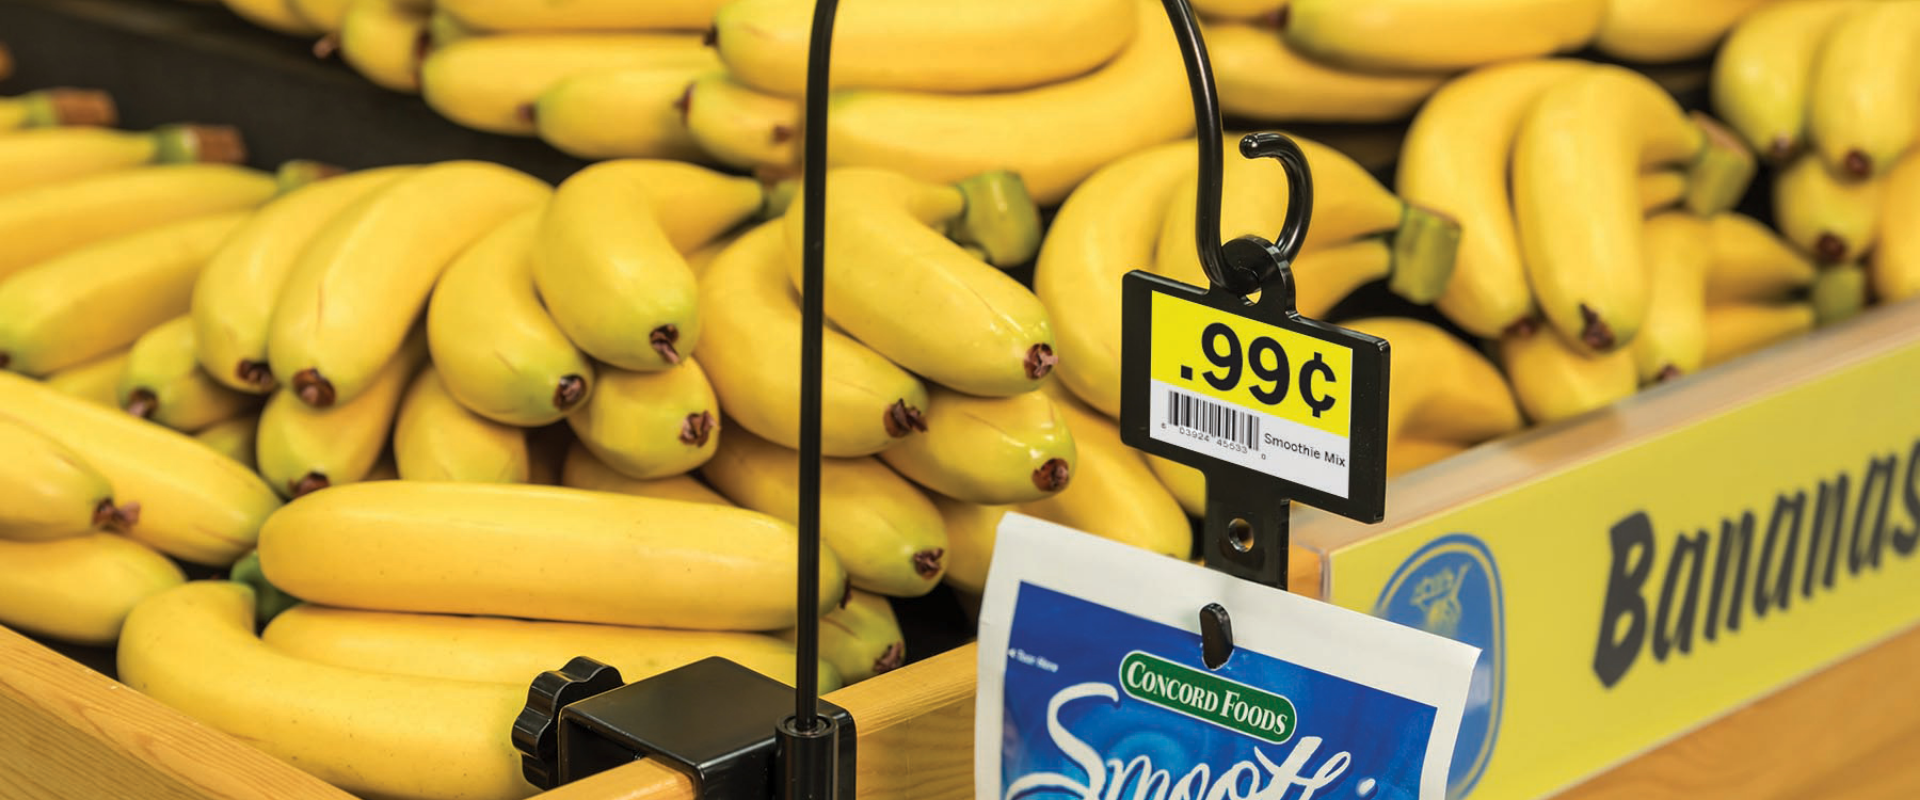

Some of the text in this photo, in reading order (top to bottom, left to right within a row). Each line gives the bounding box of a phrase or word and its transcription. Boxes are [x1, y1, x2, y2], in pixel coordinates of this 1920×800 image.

[1181, 322, 1337, 418] .99¢
[1179, 427, 1210, 442] 03924
[1216, 438, 1248, 454] 45533
[1264, 432, 1346, 467] Smoothie Mix
[1593, 437, 1920, 690] Bananas
